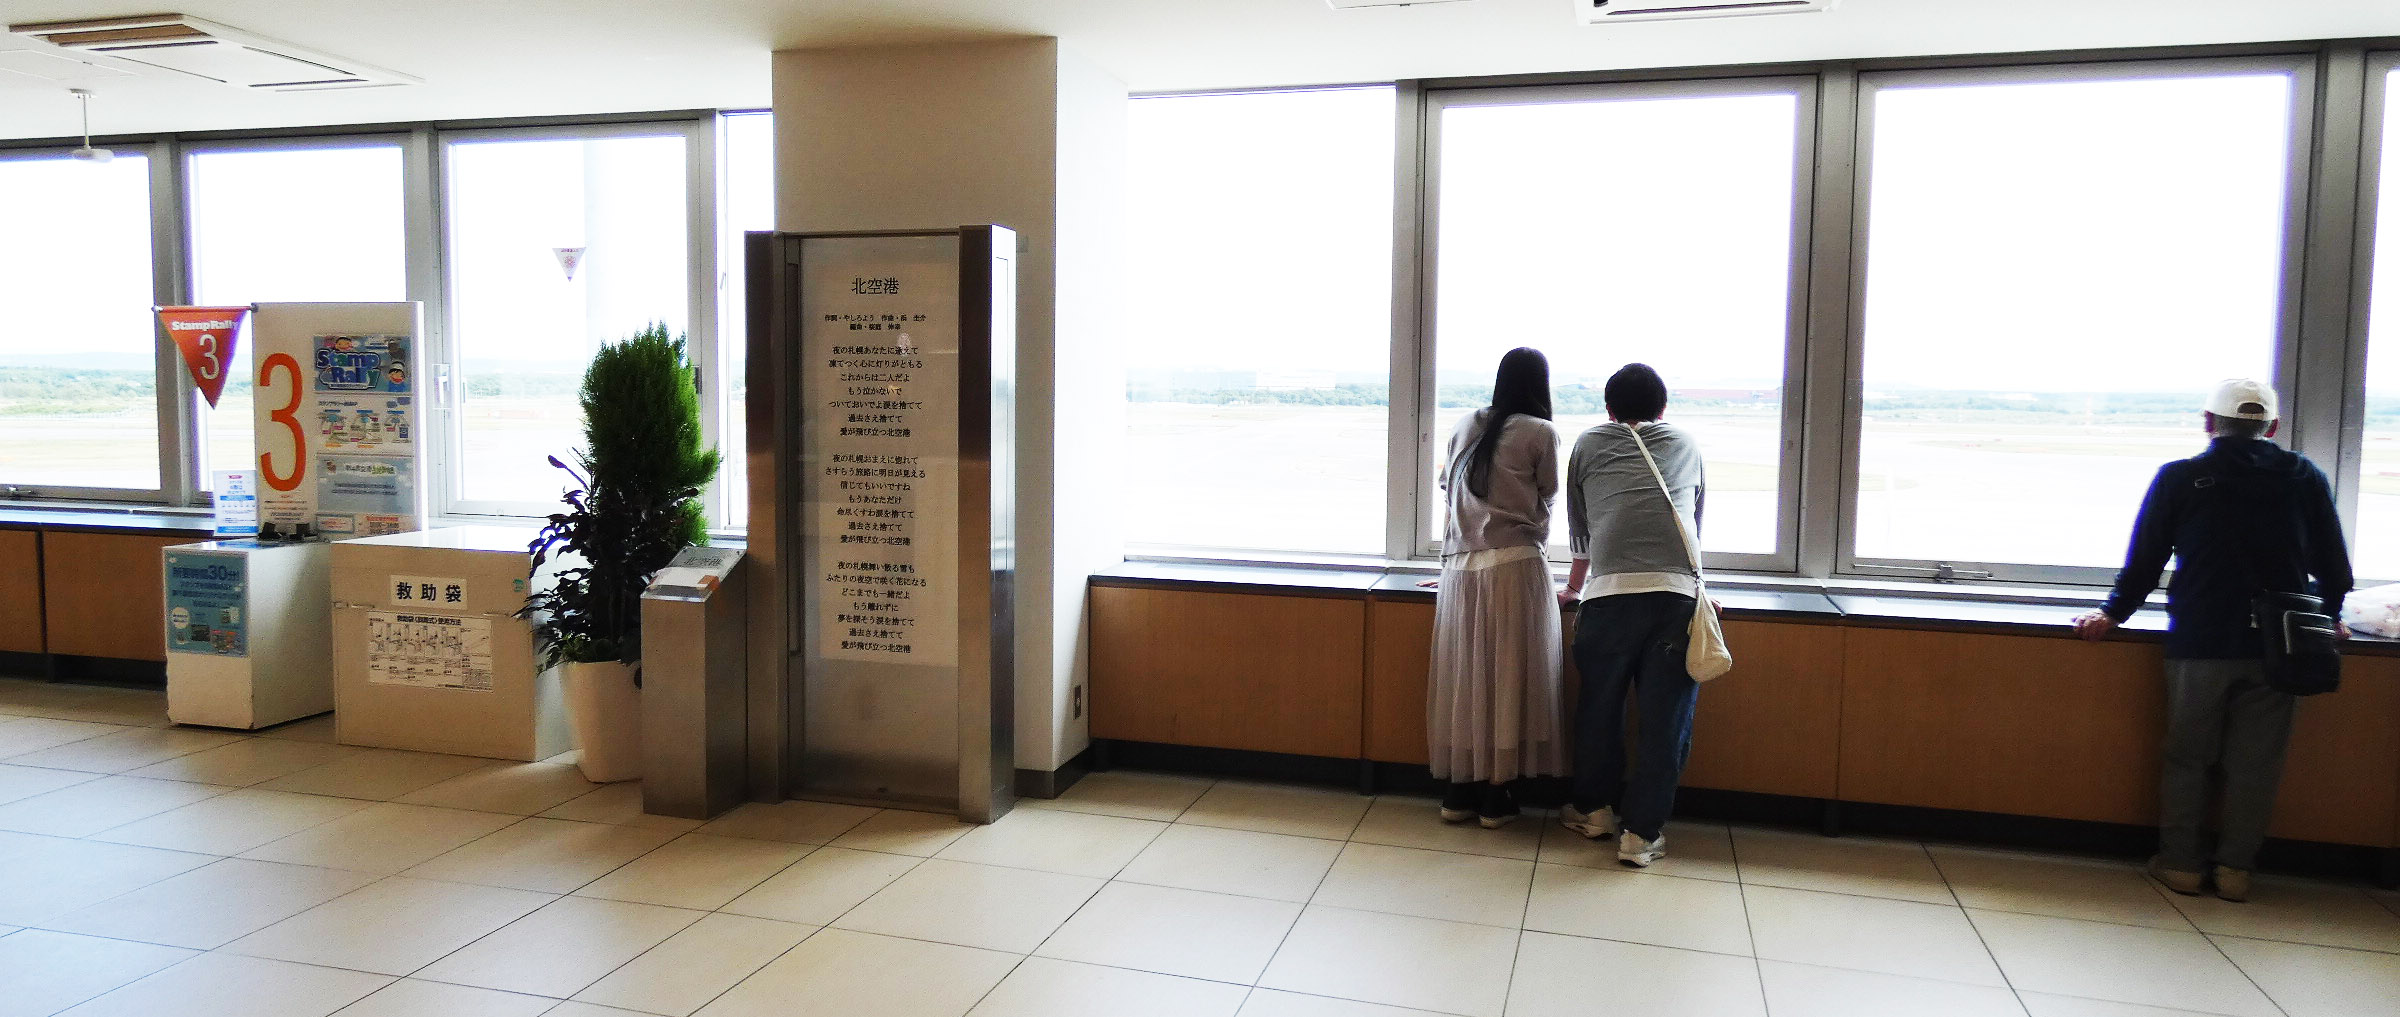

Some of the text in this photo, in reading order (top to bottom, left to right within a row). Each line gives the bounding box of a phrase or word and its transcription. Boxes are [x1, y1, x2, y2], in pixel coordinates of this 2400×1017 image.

[851, 277, 899, 295] 北空港
[199, 333, 220, 380] 3
[317, 350, 379, 368] Stamp
[829, 359, 922, 368] 凍てつく心に灯りがともる
[332, 367, 380, 387] Rally
[841, 372, 909, 382] これからは二人だよ
[848, 387, 902, 395] もう泣かないで
[829, 400, 922, 410] ついておいでよ涙を捨てて
[260, 353, 306, 492] 3
[848, 414, 902, 423] 過去さえ捨てて
[840, 427, 911, 437] 愛が飛び立つ北空港
[833, 454, 918, 464] 夜の札幌おまえに惚れて
[826, 467, 925, 478] さすらう旅路に明日が見える
[840, 481, 910, 491] 信じてもいいですね
[849, 495, 902, 504] もうあなただけ
[837, 507, 914, 518] 命尽くすわ涙を捨てて
[848, 522, 902, 531] 過去さえ捨てて
[840, 535, 910, 546] 愛が飛び立つ北空港
[837, 561, 914, 573] 夜の札幌舞い散る雪も
[826, 574, 926, 587] ふたりの夜空で咲く花になる
[397, 582, 461, 602] 救助袋
[842, 588, 910, 599] どこまでも一緒だよ
[854, 602, 898, 612] もう離れずに
[837, 614, 914, 626] 夢を探そう涙を捨てて
[849, 628, 903, 639] 過去さえ捨てて
[842, 641, 911, 653] 愛が飛び立つ北空港
